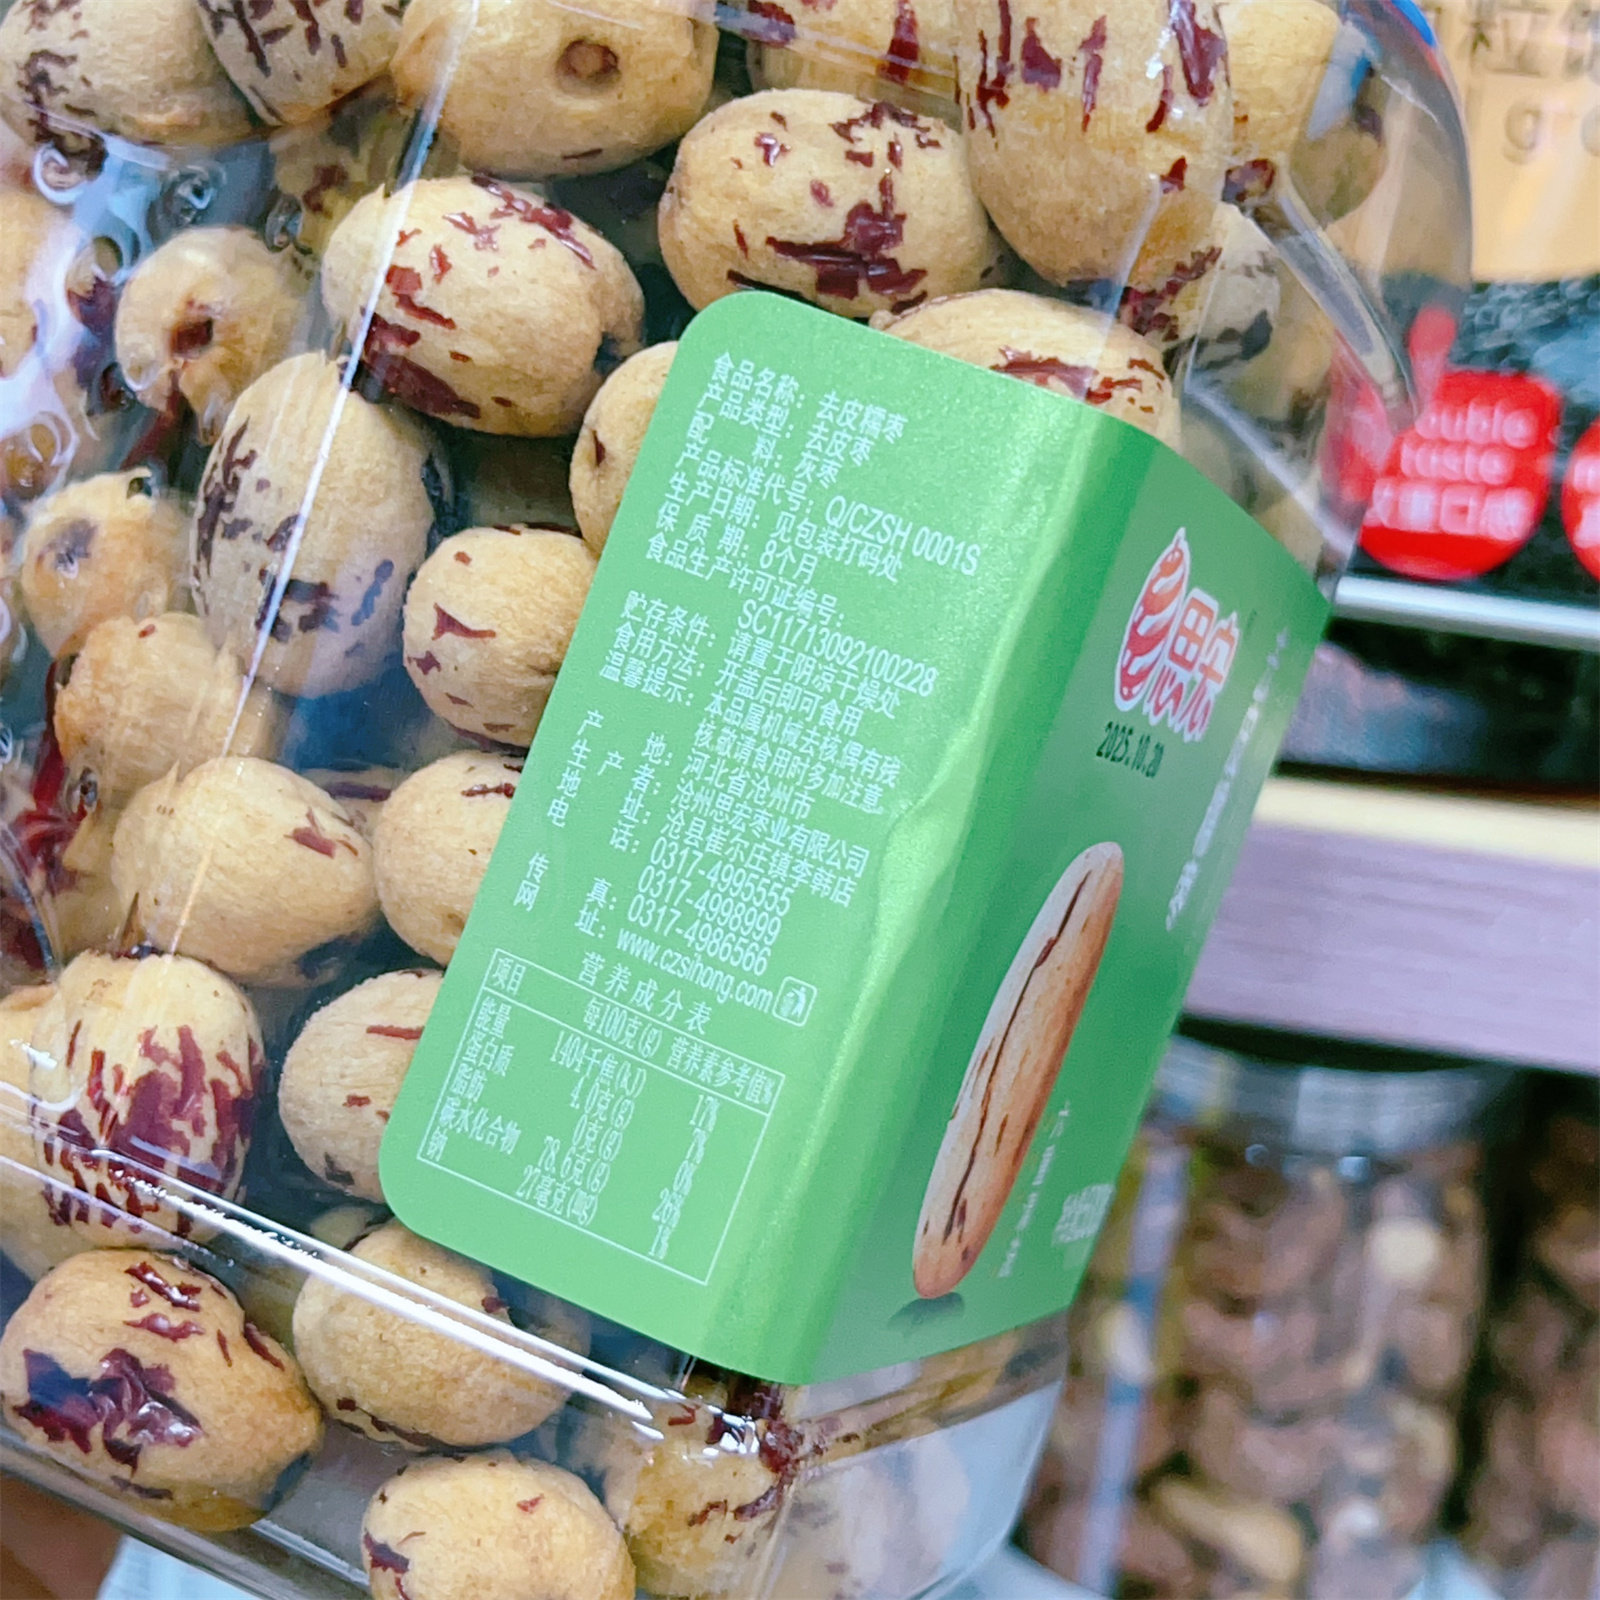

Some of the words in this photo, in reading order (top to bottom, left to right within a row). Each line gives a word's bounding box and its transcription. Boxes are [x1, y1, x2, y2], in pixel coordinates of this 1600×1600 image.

[912, 526, 984, 576] 0001S
[738, 599, 939, 697] SC11713092100228
[638, 866, 781, 946] 0317-4998999
[578, 952, 712, 1035] 营养成分表
